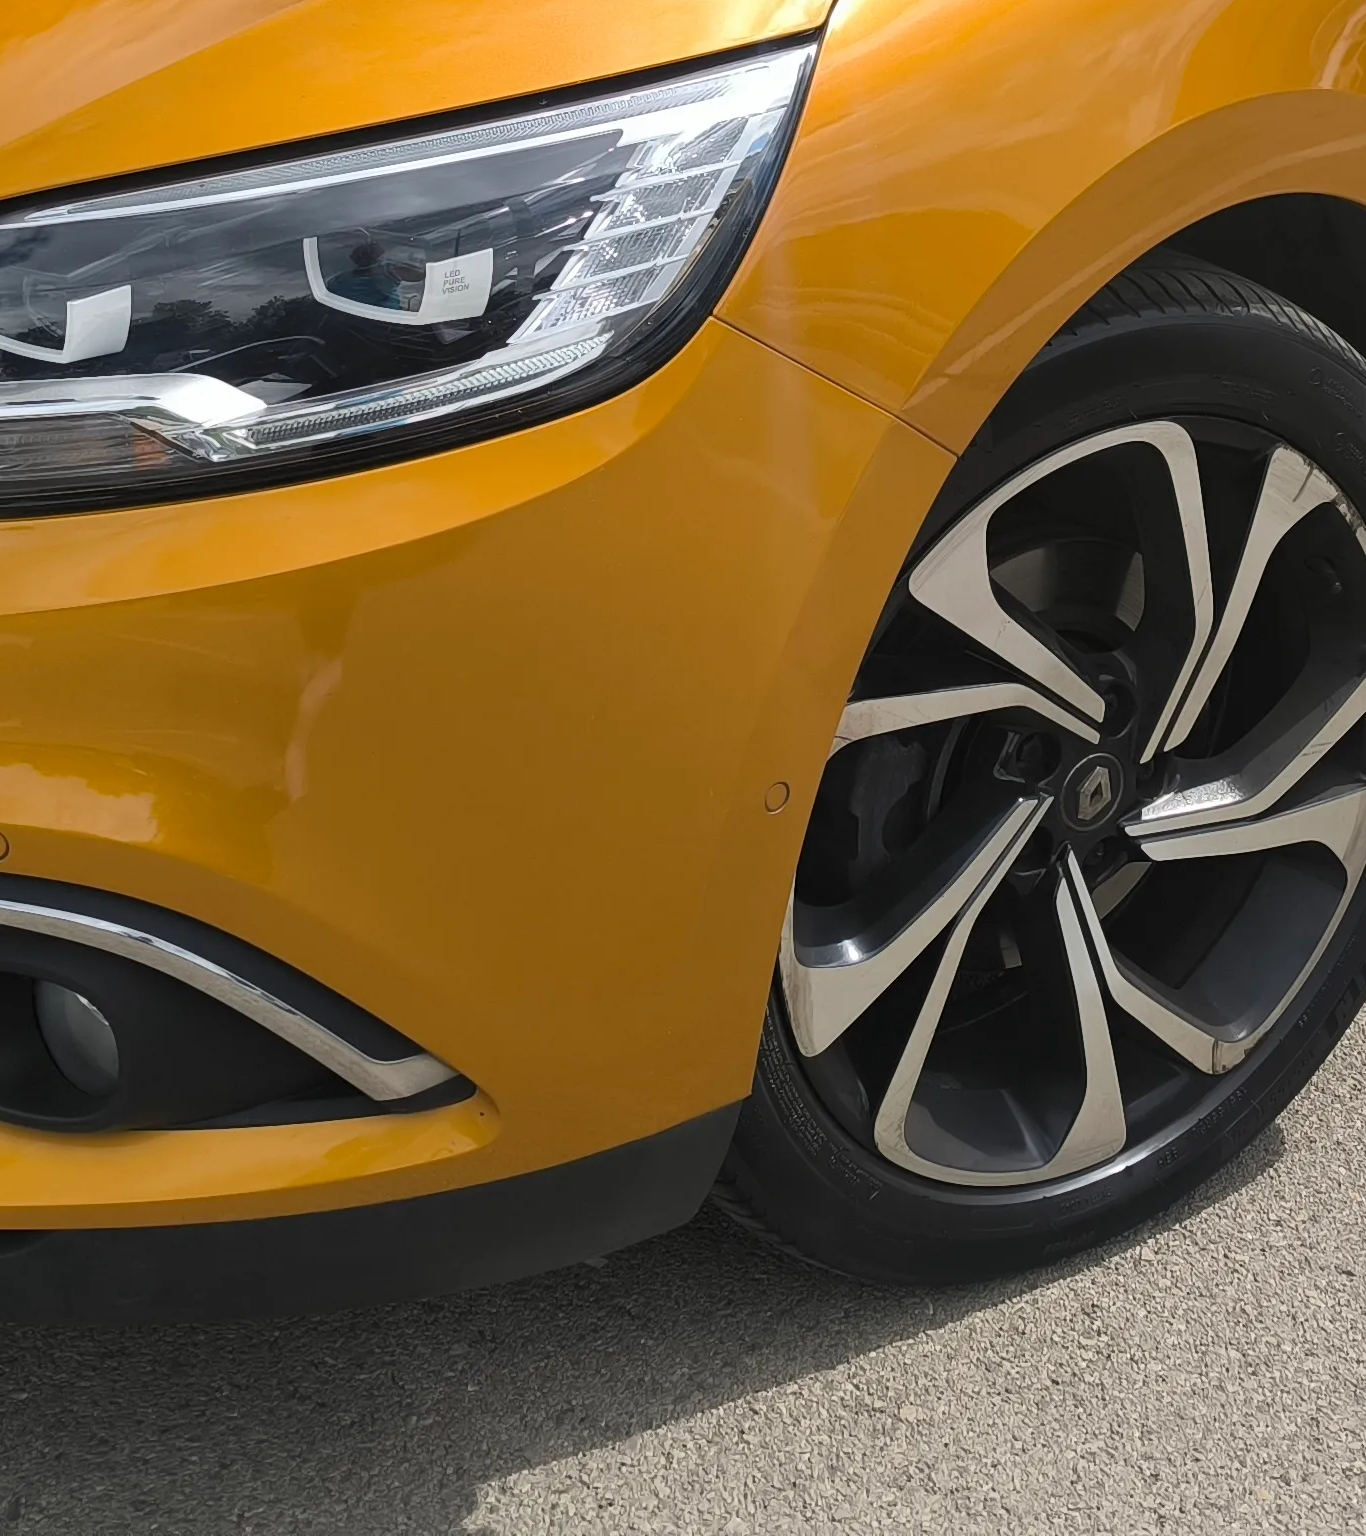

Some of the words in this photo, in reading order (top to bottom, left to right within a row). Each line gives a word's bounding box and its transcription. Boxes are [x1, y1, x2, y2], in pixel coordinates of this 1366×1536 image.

[444, 269, 461, 279] LED
[443, 276, 466, 287] PURE
[442, 283, 470, 295] VISION
